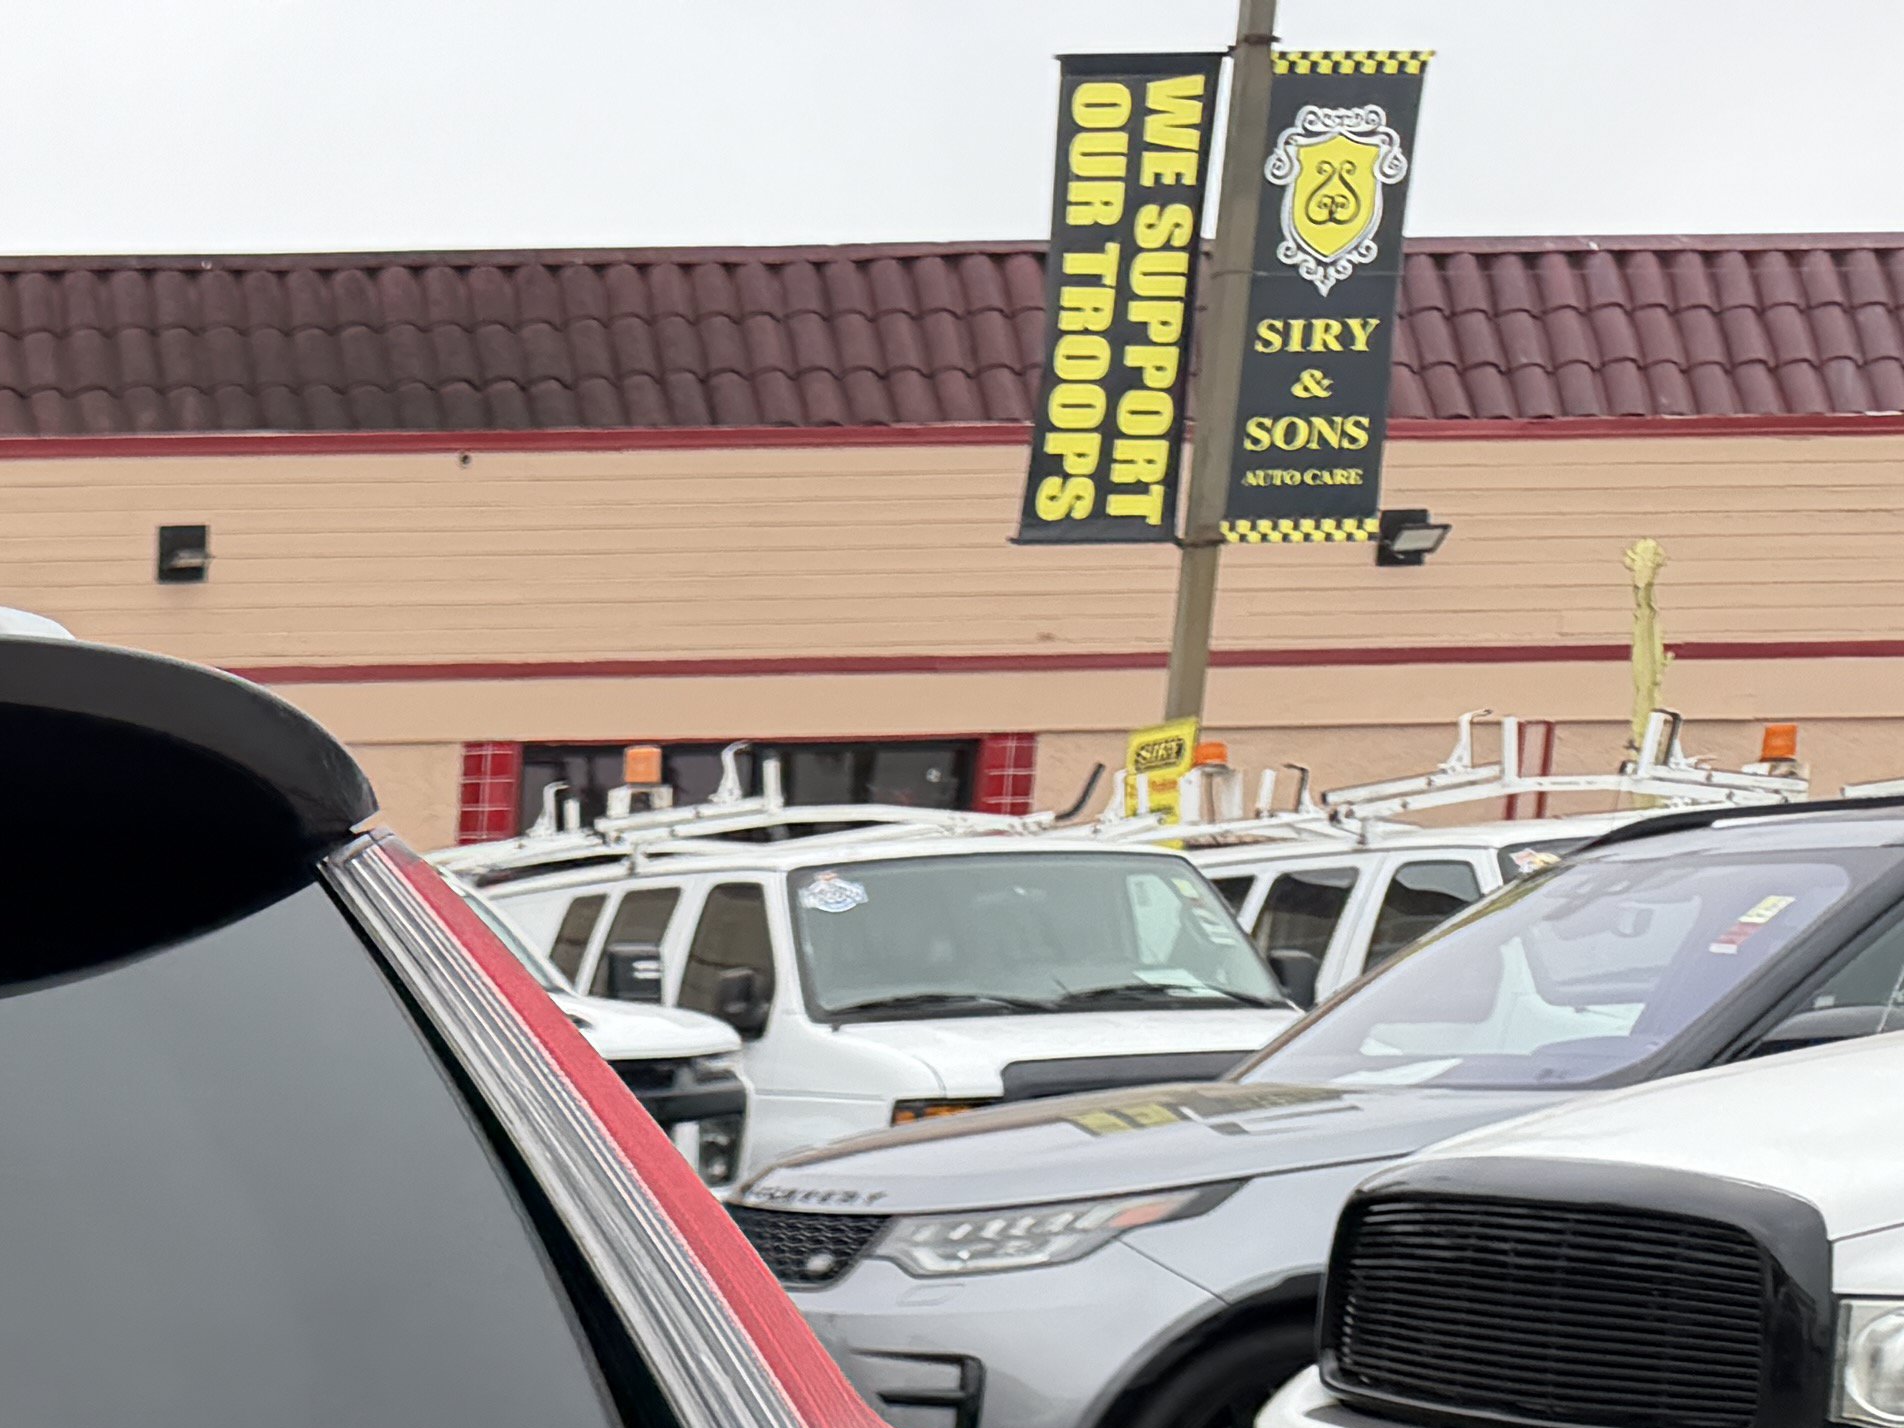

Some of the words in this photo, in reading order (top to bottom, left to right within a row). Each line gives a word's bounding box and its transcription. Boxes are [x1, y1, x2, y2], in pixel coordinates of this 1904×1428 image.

[1065, 82, 1132, 226] OUR
[1139, 74, 1206, 188] WE
[1106, 203, 1194, 525] SUPPORT
[1253, 317, 1380, 353] SIRY
[1034, 241, 1122, 522] TROOPS
[1291, 369, 1333, 398] &
[1243, 416, 1371, 452] SONS
[1241, 468, 1302, 486] AUTO
[1303, 467, 1364, 486] CARE
